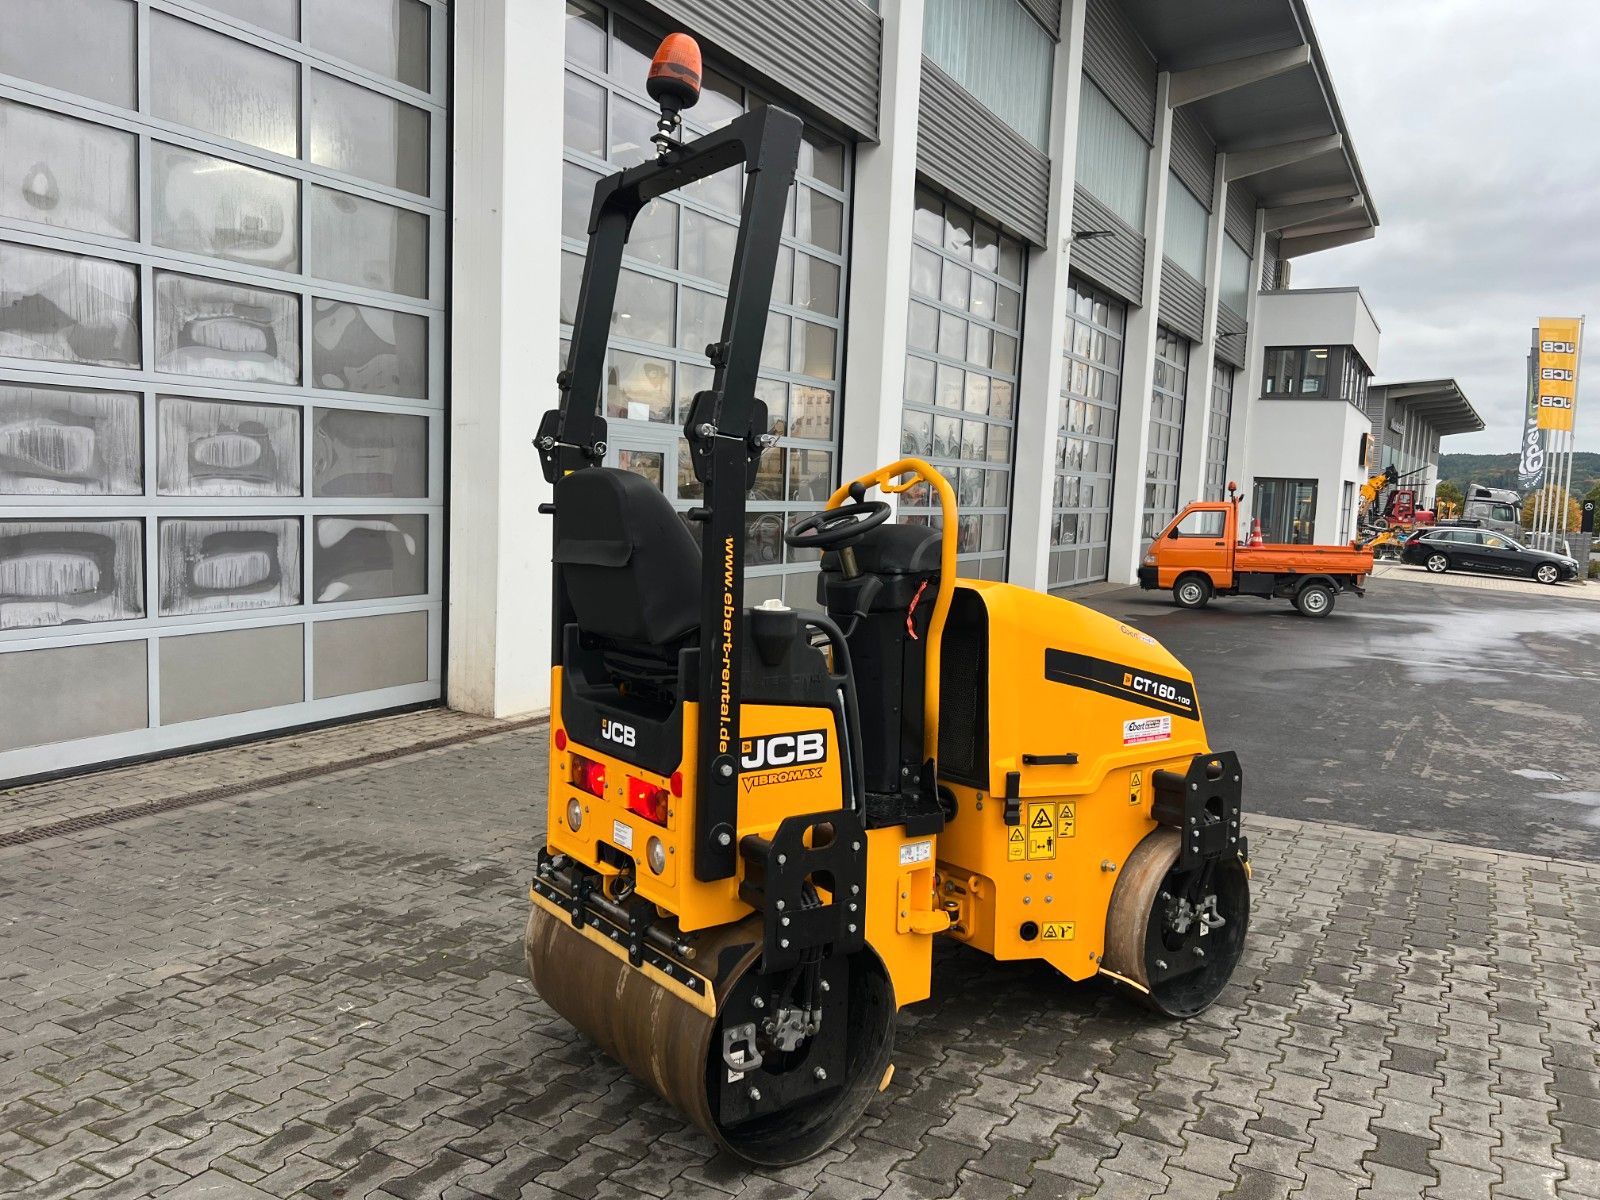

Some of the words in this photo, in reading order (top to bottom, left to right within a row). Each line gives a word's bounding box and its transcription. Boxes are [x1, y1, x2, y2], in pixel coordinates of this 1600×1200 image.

[719, 537, 735, 753] www.ebert-rental.de
[601, 719, 636, 748] JCB
[741, 733, 824, 769] JCB
[741, 767, 823, 793] VIBROMAX
